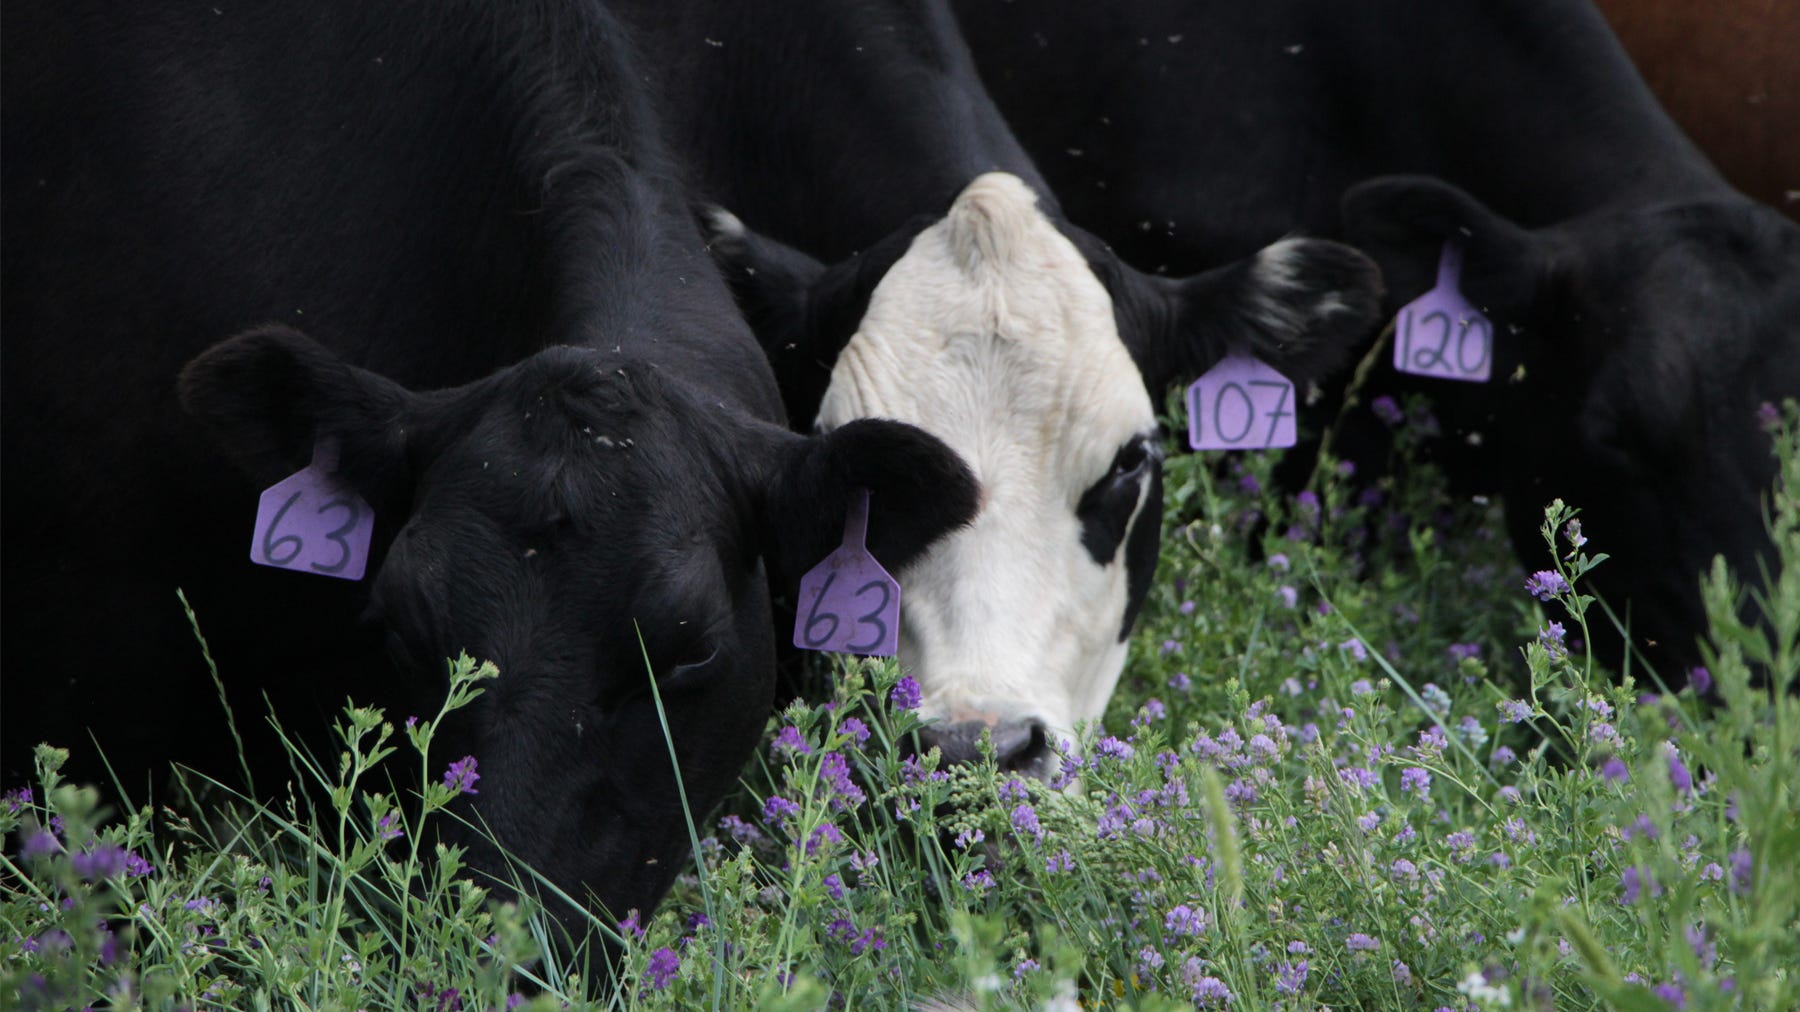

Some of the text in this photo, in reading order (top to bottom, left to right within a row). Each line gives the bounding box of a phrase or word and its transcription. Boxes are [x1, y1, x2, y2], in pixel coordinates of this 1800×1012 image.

[1402, 309, 1488, 374] 120
[1193, 380, 1292, 448] 107
[263, 491, 359, 573] 63
[804, 571, 890, 653] 63
